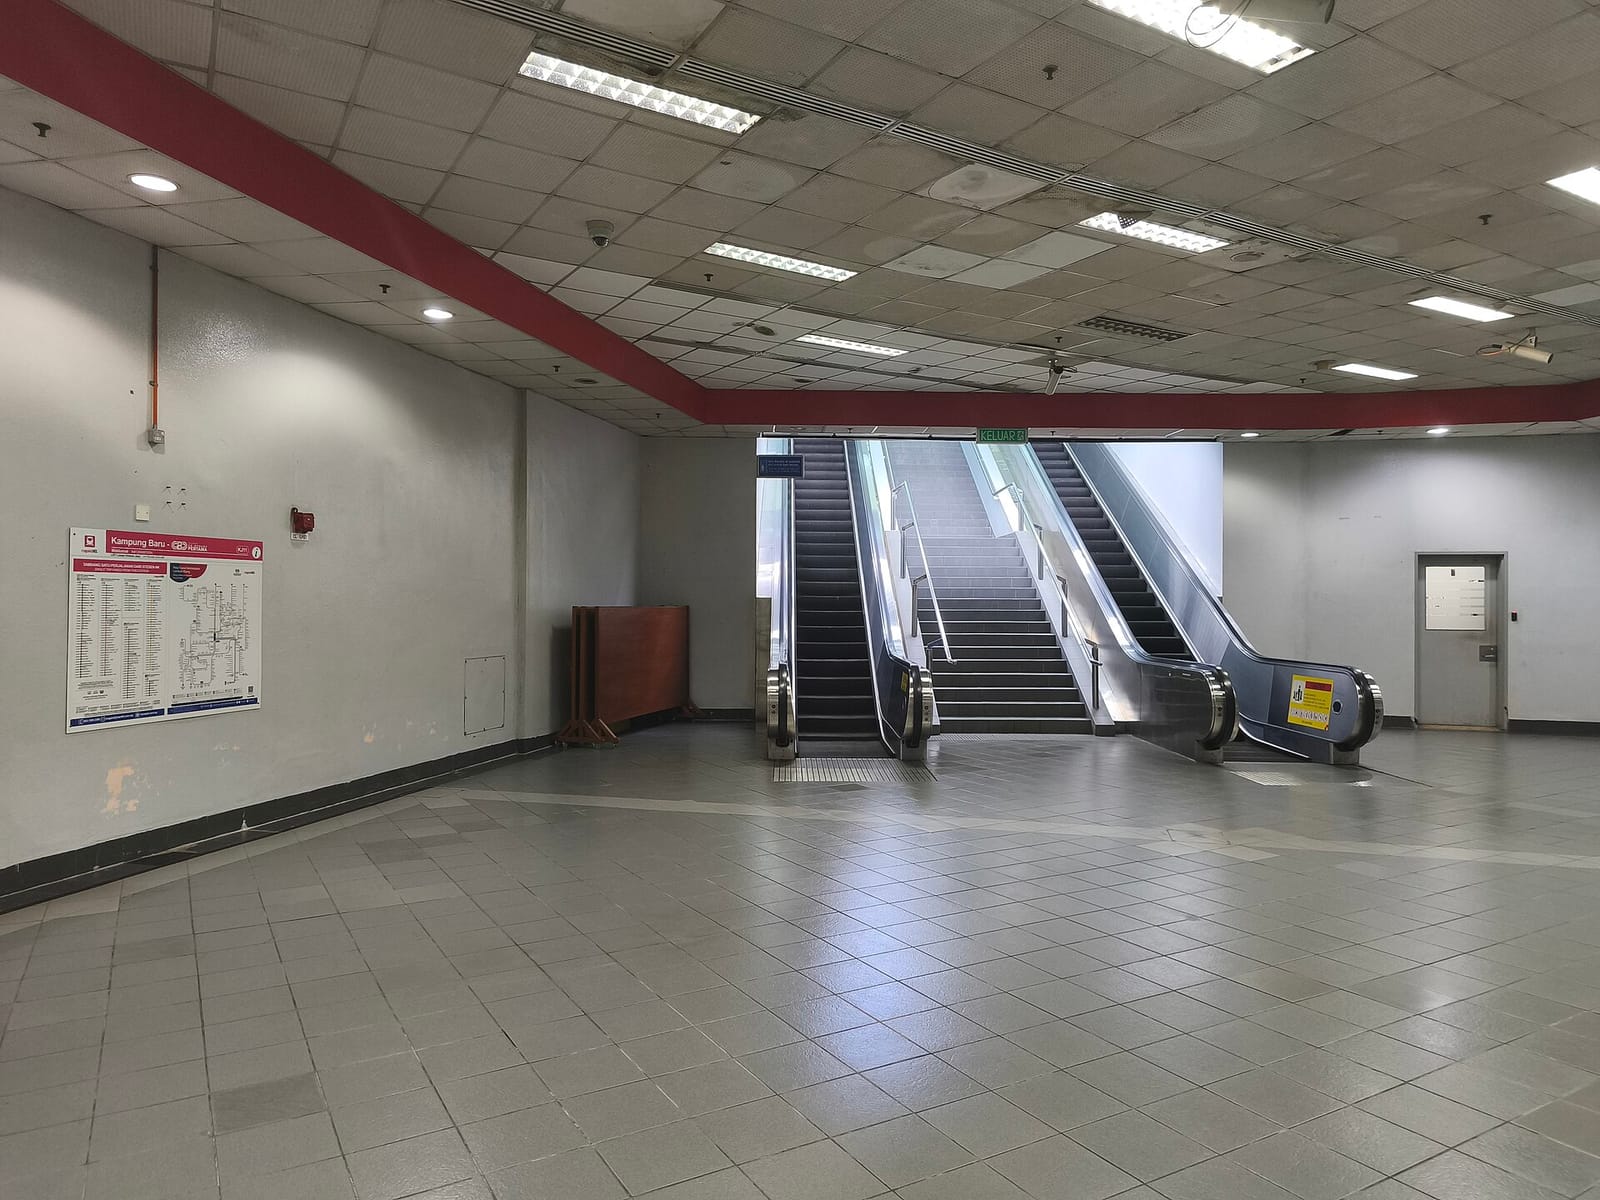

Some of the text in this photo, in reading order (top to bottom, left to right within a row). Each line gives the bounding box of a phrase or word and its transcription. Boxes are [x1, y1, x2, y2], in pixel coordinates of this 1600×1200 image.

[981, 430, 1015, 441] KELUAR
[111, 536, 147, 548] Kampung
[148, 539, 166, 548] Baru
